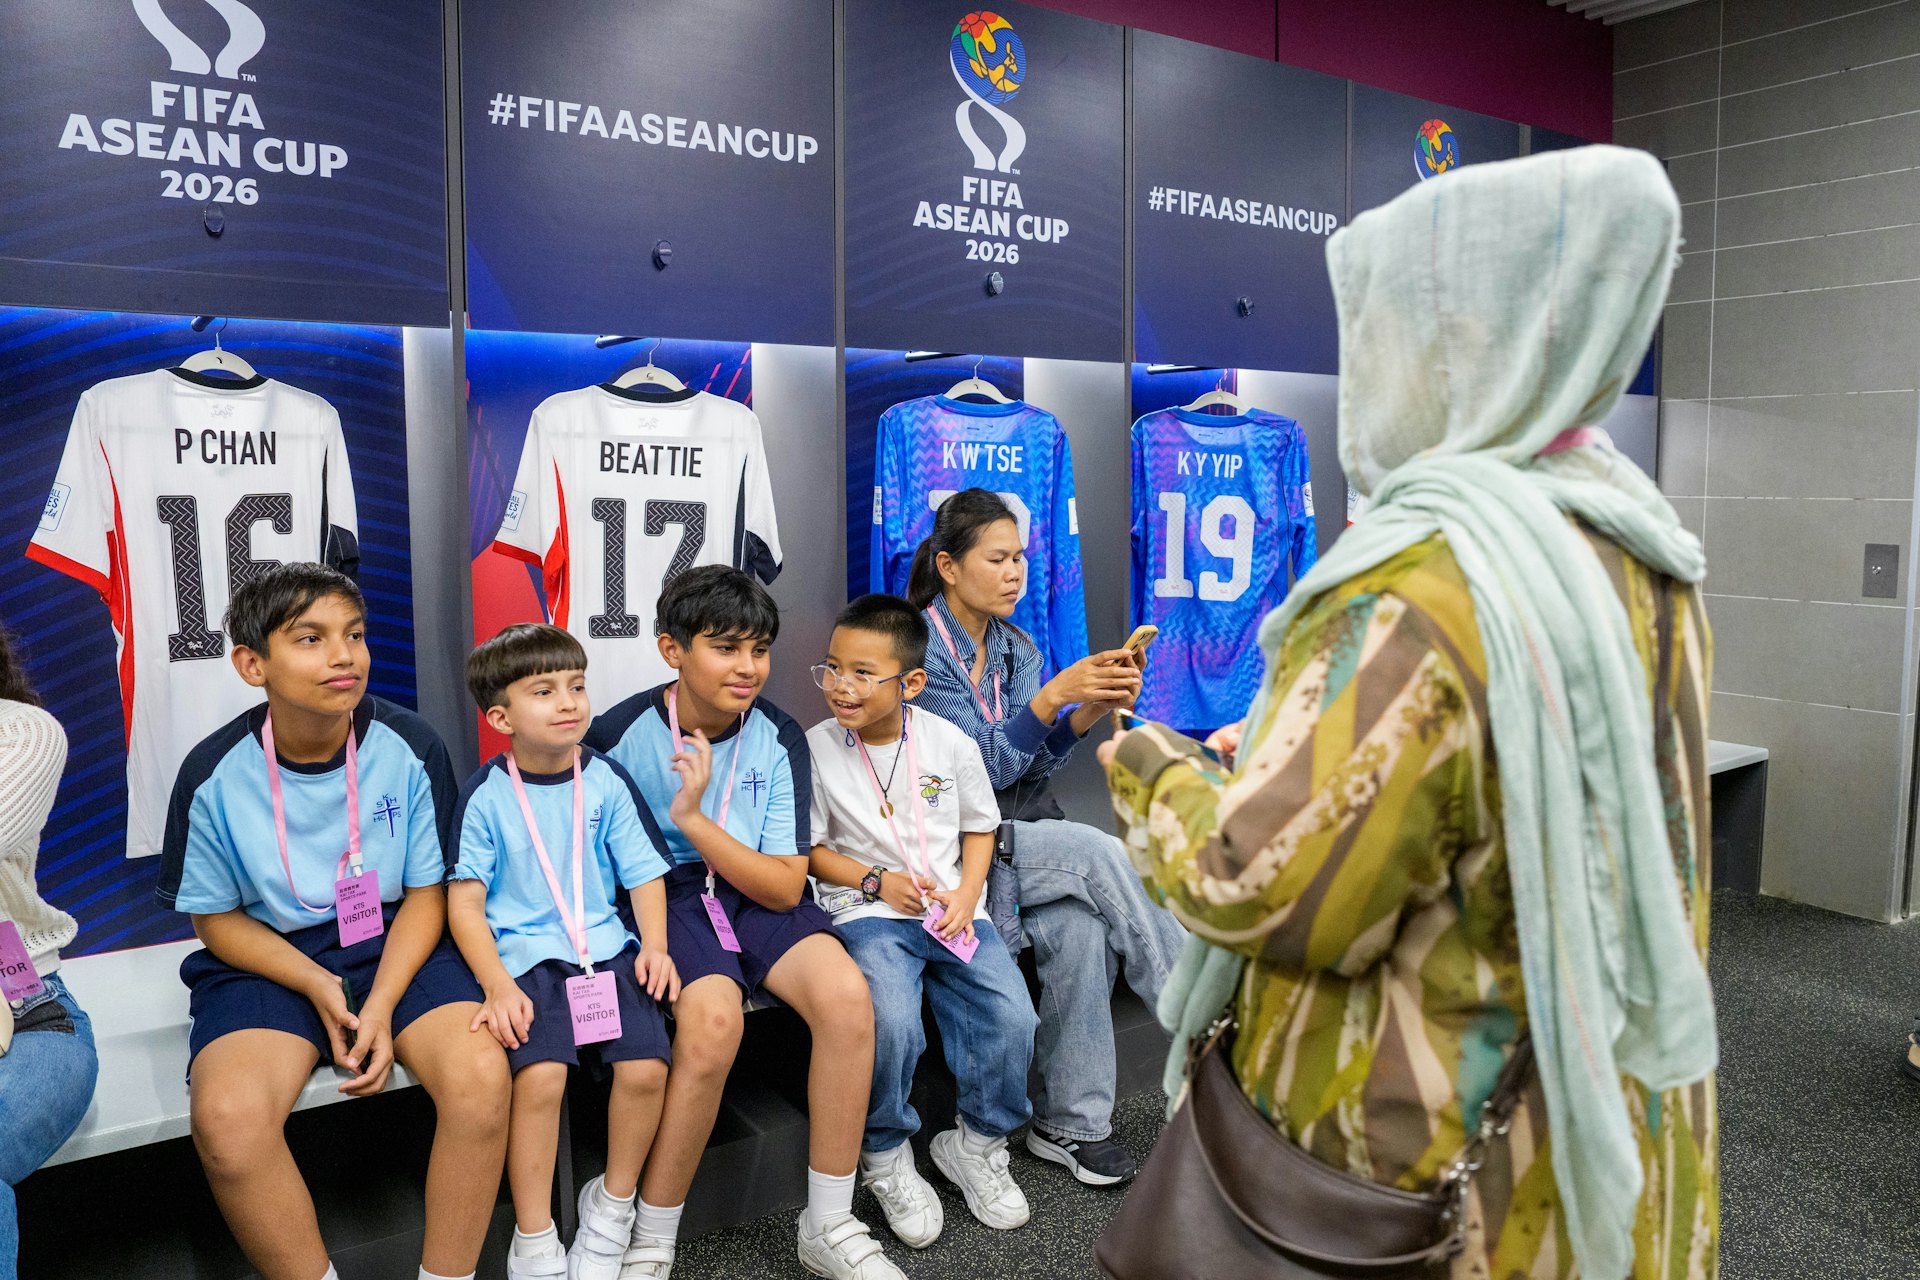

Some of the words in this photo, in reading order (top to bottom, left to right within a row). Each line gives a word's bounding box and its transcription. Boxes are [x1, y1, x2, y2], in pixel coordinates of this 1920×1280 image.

[150, 81, 265, 130] FIFA
[58, 113, 242, 168] ASEAN
[253, 138, 348, 178] CUP
[488, 92, 818, 164] #FIFAASEANCUP
[160, 170, 260, 206] 2026
[962, 175, 1024, 210] FIFA
[912, 200, 1010, 238] ASEAN
[1016, 214, 1069, 244] CUP
[1149, 187, 1338, 236] #FIFAASEANCUP
[965, 239, 1020, 265] 2026
[200, 429, 277, 465] CHAN
[599, 441, 703, 478] BEATTIE
[1153, 491, 1256, 602] 19
[588, 497, 708, 639] 17
[342, 907, 378, 925] VISITOR
[353, 902, 365, 910] KTS
[576, 1009, 616, 1024] VISITOR
